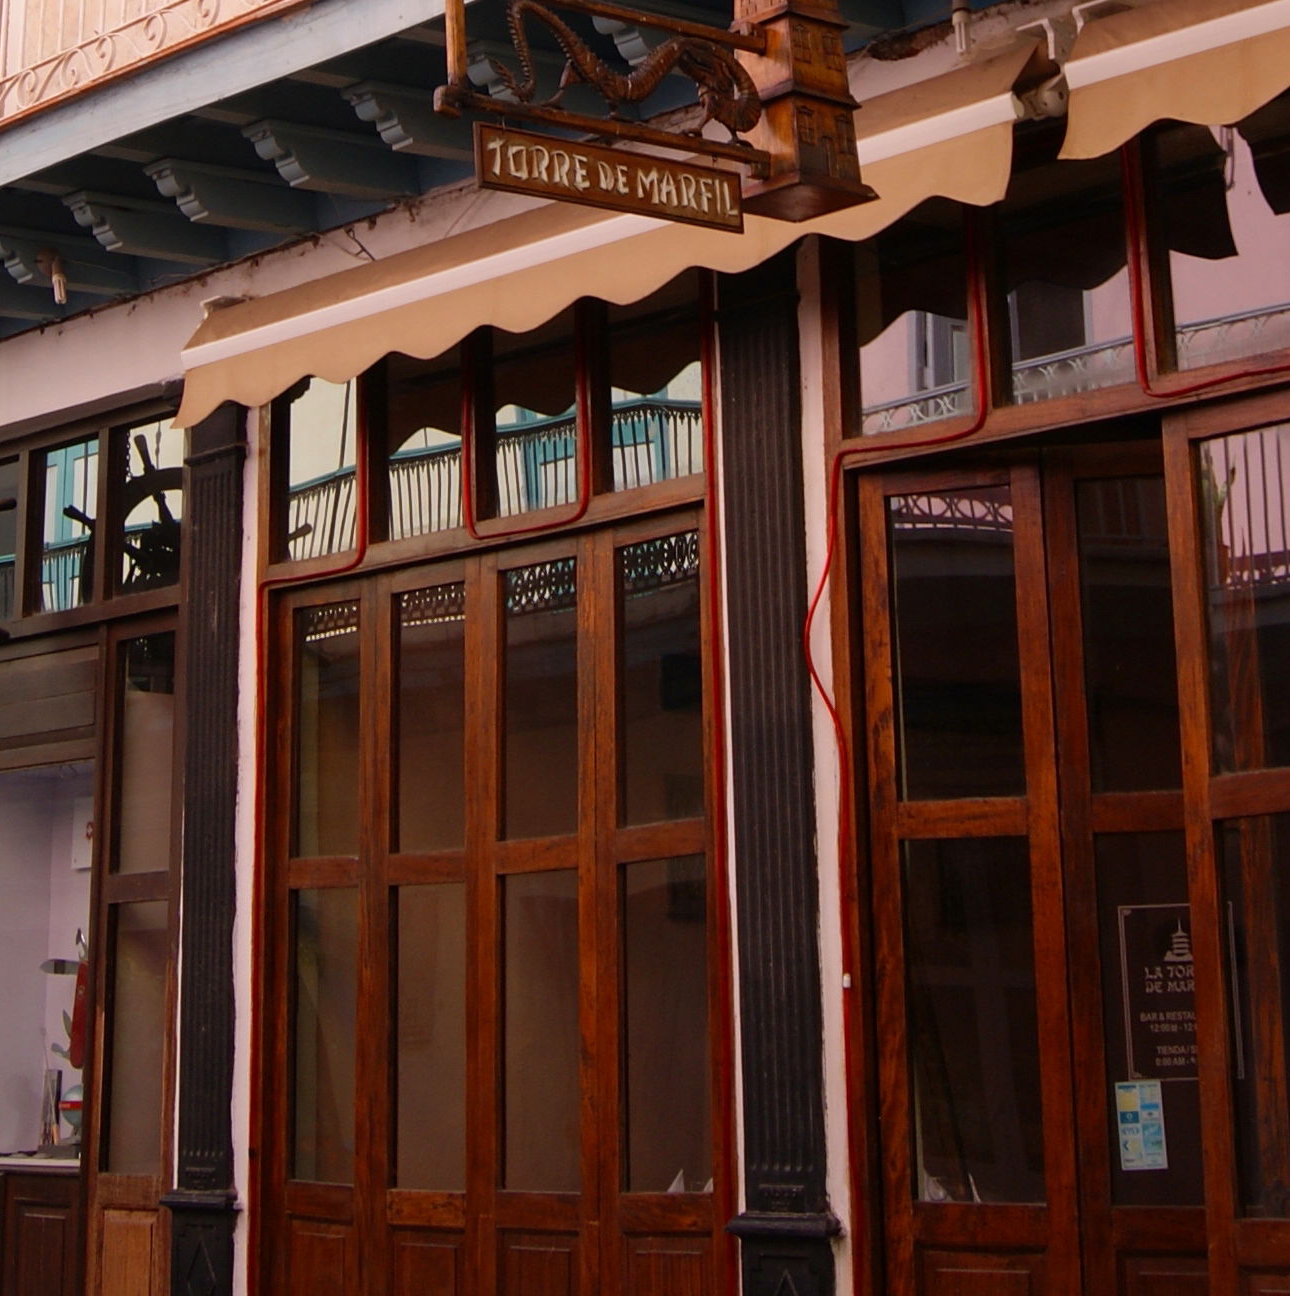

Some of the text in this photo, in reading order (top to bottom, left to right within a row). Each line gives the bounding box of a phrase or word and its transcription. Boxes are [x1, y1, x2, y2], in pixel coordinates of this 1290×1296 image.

[487, 138, 739, 217] TORRE DE MARFIL
[1144, 966, 1163, 979] LA
[1145, 981, 1163, 993] DE
[1140, 1011, 1157, 1022] BAR
